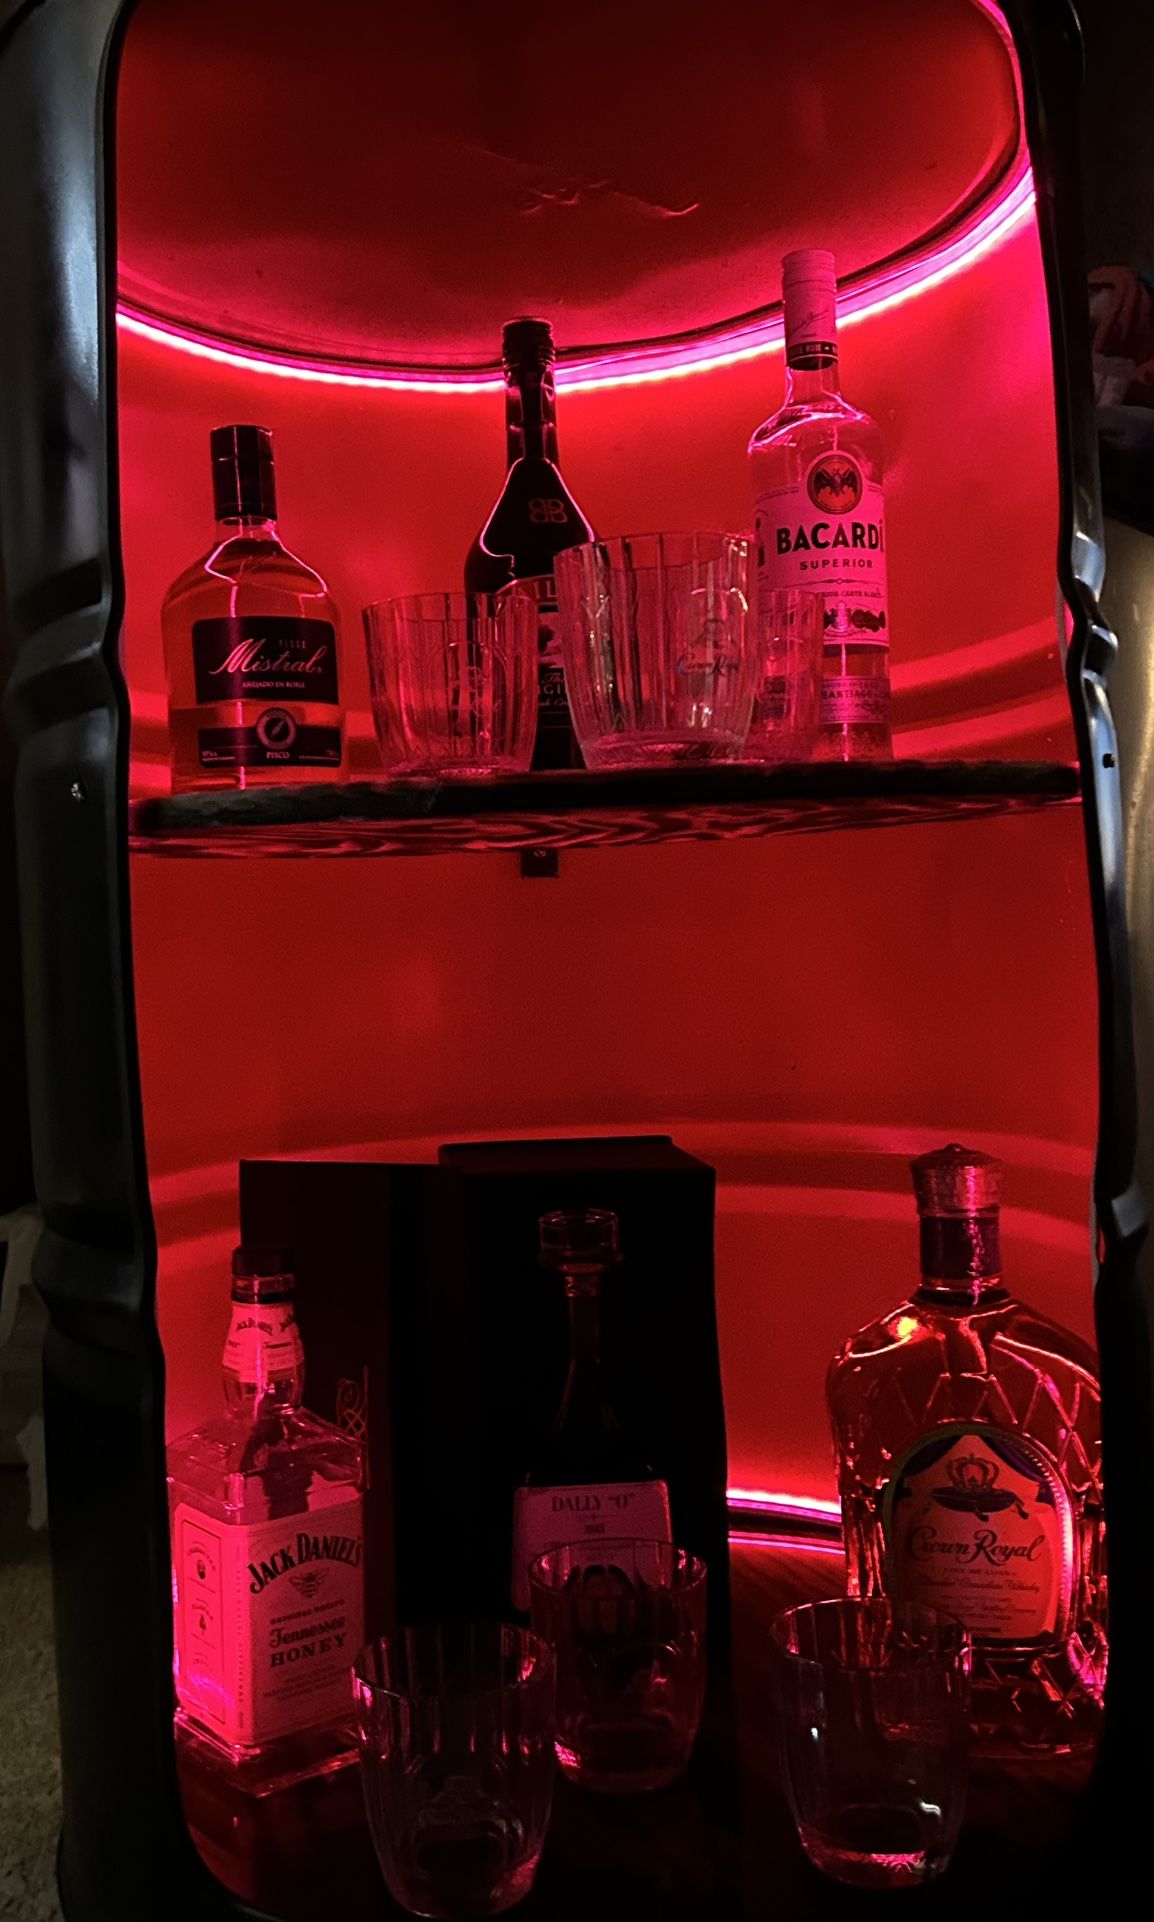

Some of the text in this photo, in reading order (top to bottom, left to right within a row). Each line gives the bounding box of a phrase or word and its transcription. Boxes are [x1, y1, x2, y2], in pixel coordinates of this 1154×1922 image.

[800, 558, 873, 571] SUPERIOR
[208, 638, 329, 675] Mistral
[266, 750, 290, 760] PISCO
[551, 1495, 601, 1512] DALLY
[907, 1526, 1046, 1567] Crown Royal
[247, 1545, 297, 1594] JACK
[269, 1616, 346, 1649] Tennessee
[271, 1632, 347, 1668] HONEY
